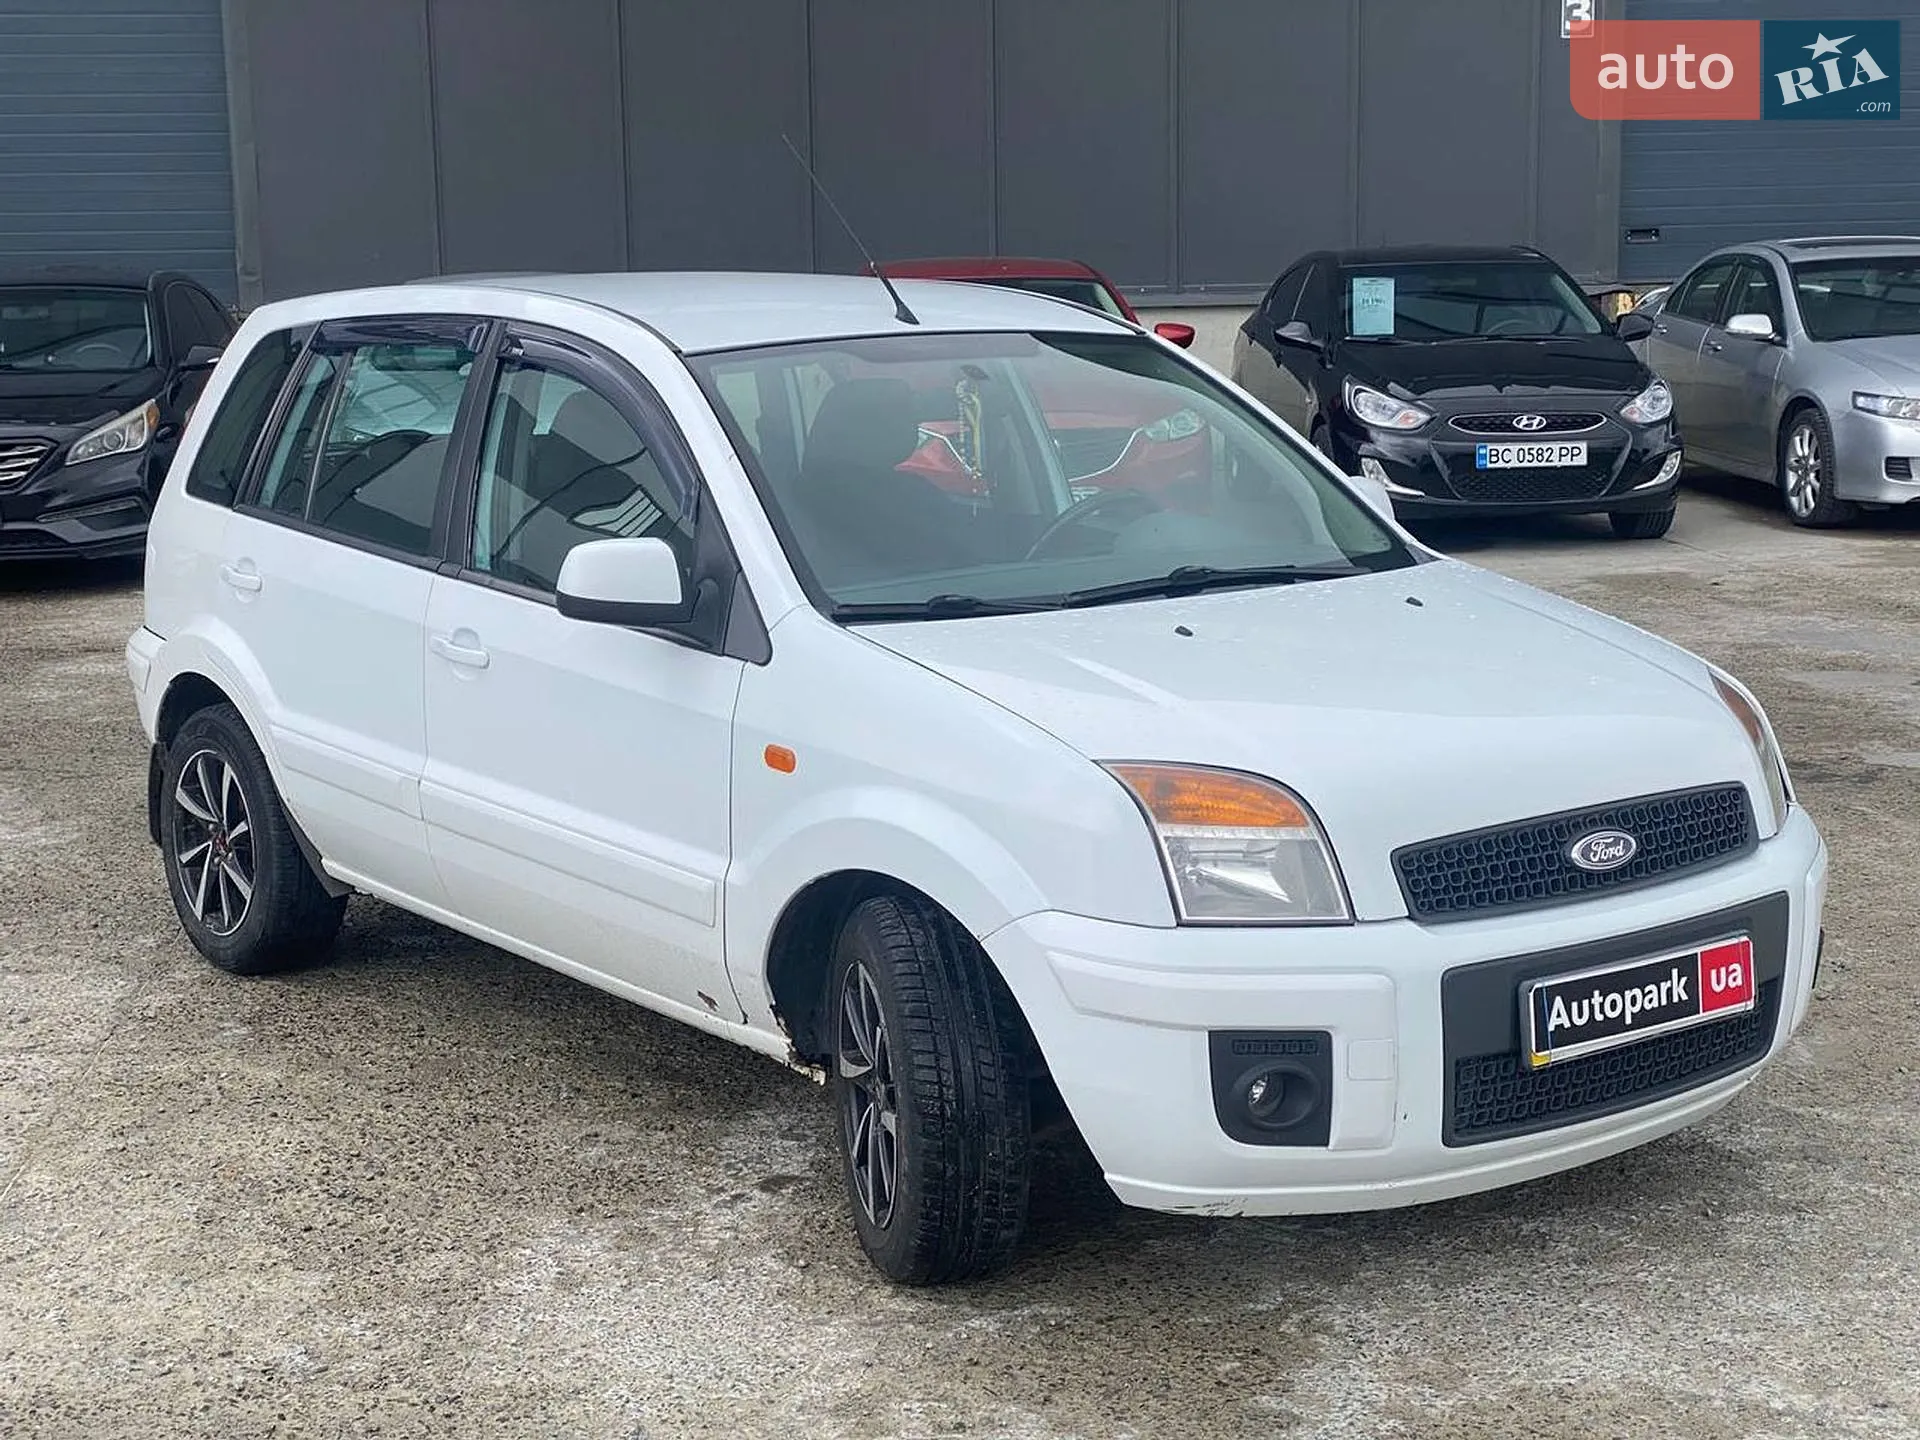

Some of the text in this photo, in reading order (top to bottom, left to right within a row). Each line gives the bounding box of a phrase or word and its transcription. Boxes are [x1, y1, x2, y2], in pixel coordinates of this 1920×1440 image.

[1565, 0, 1591, 31] 3
[1489, 446, 1582, 464] BC 0582 PP
[1589, 836, 1625, 862] Ford
[1547, 962, 1743, 1032] Autopark ua
